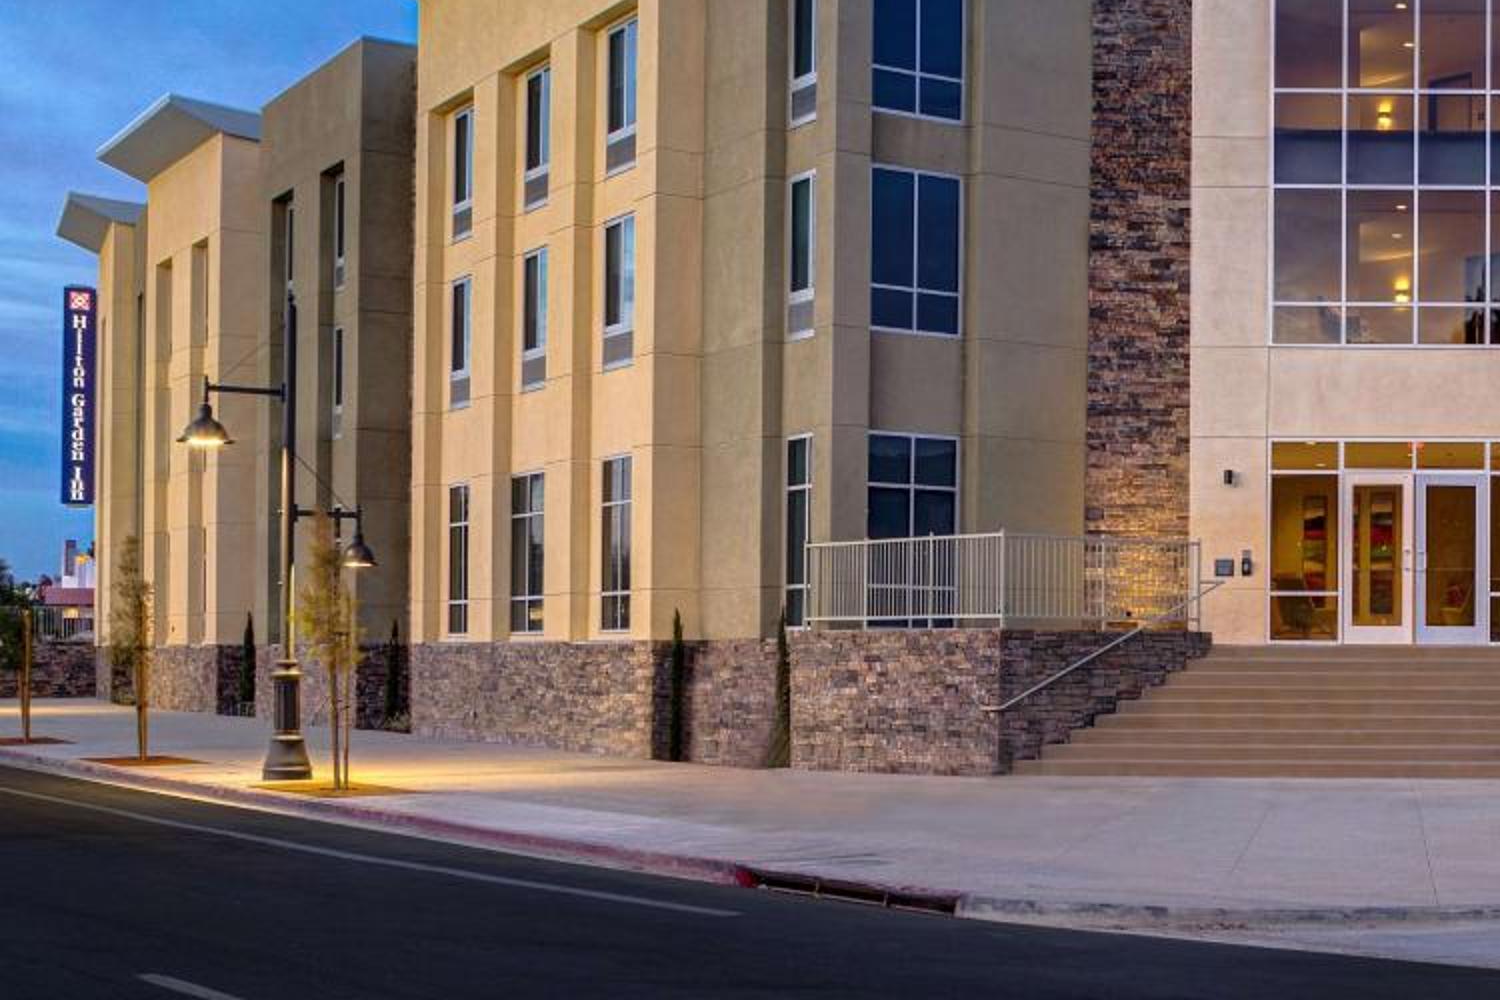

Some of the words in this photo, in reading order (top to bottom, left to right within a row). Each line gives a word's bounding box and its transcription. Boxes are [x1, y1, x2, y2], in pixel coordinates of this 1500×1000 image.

[72, 315, 87, 388] Hilton
[71, 393, 86, 461] Garden
[70, 467, 85, 500] Inn
